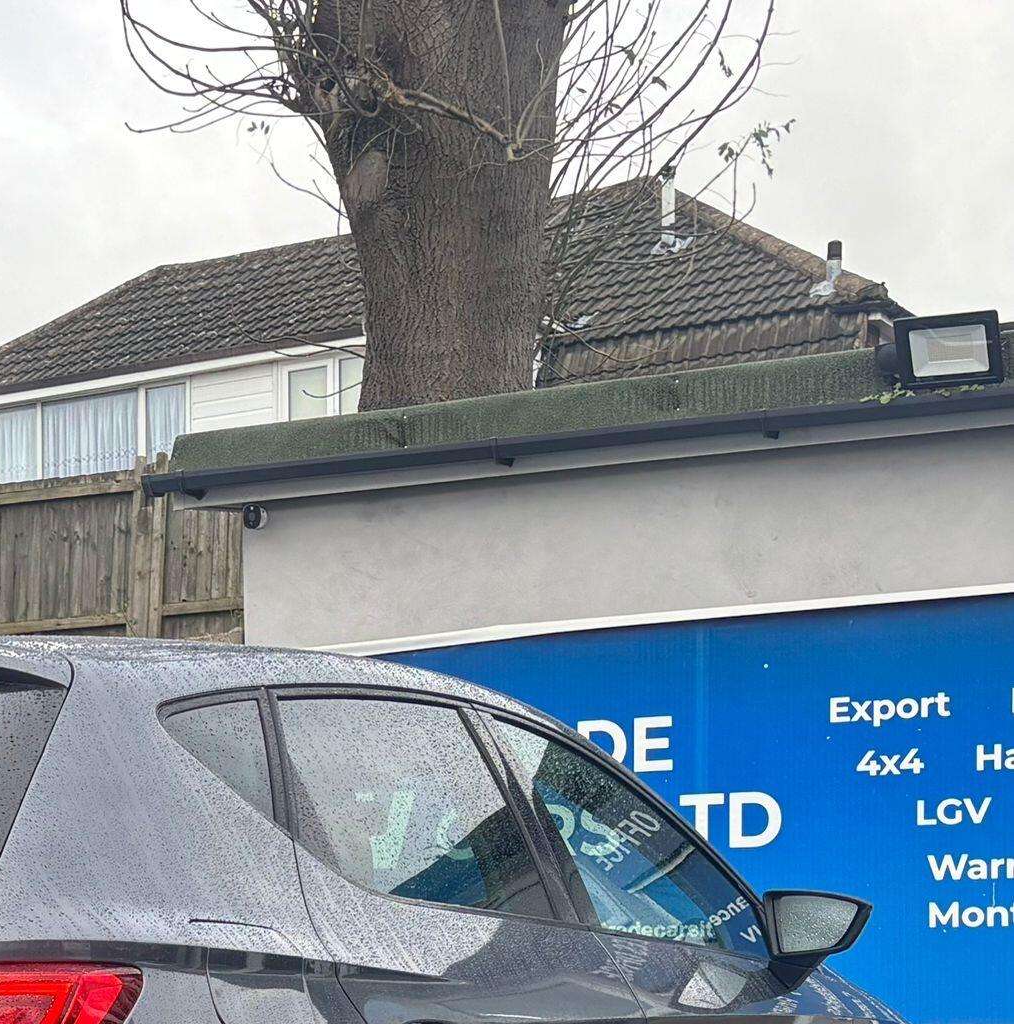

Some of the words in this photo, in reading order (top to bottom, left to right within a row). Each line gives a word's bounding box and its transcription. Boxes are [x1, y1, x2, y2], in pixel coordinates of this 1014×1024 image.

[829, 691, 951, 727] Export
[576, 715, 674, 773] DE
[856, 747, 925, 776] 4x4
[679, 791, 783, 849] TD
[916, 796, 993, 826] LGV
